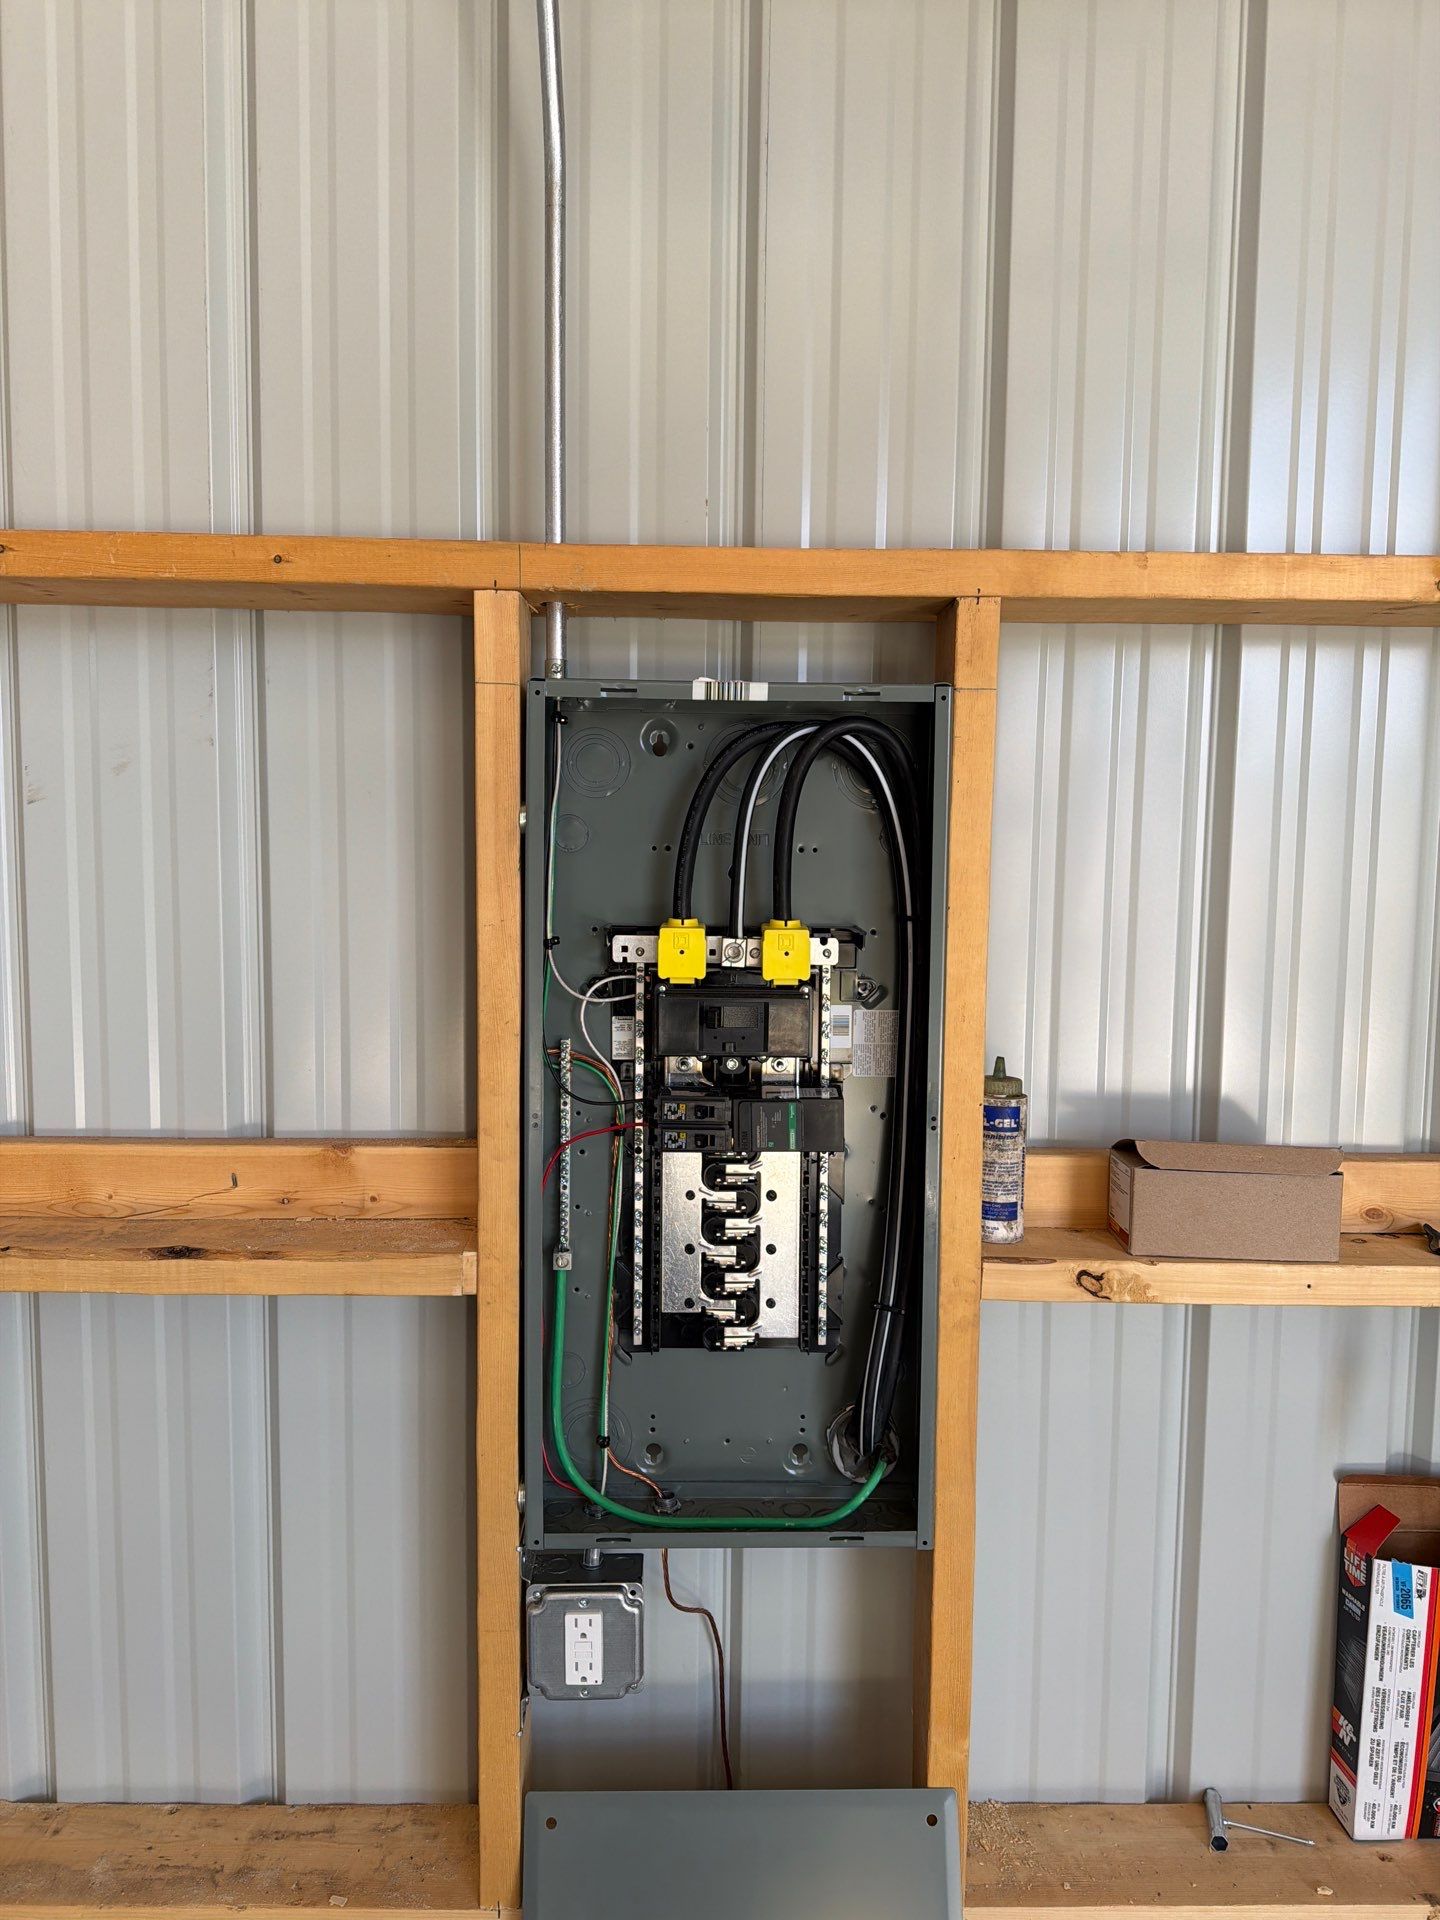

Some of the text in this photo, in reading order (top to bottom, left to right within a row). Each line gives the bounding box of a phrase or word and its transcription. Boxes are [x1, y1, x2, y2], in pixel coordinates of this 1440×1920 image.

[1344, 1547, 1367, 1573] LIFE
[1344, 1559, 1367, 1585] TIME
[1374, 1625, 1382, 1661] EINZUFANGEN
[1403, 1629, 1411, 1670] CONTAMINANTS
[1372, 1698, 1380, 1733] LUFTSTROMS
[1379, 1688, 1387, 1729] VERBESSERUNG
[1404, 1691, 1413, 1720] AMÉLIORER
[1375, 1738, 1382, 1748] UM
[1396, 1741, 1405, 1783] ÉCONOMISER DU
[1372, 1771, 1380, 1786] GELD
[1389, 1775, 1397, 1799] L'ARGENT
[1369, 1821, 1376, 1829] KM
[1390, 1821, 1397, 1829] KM
